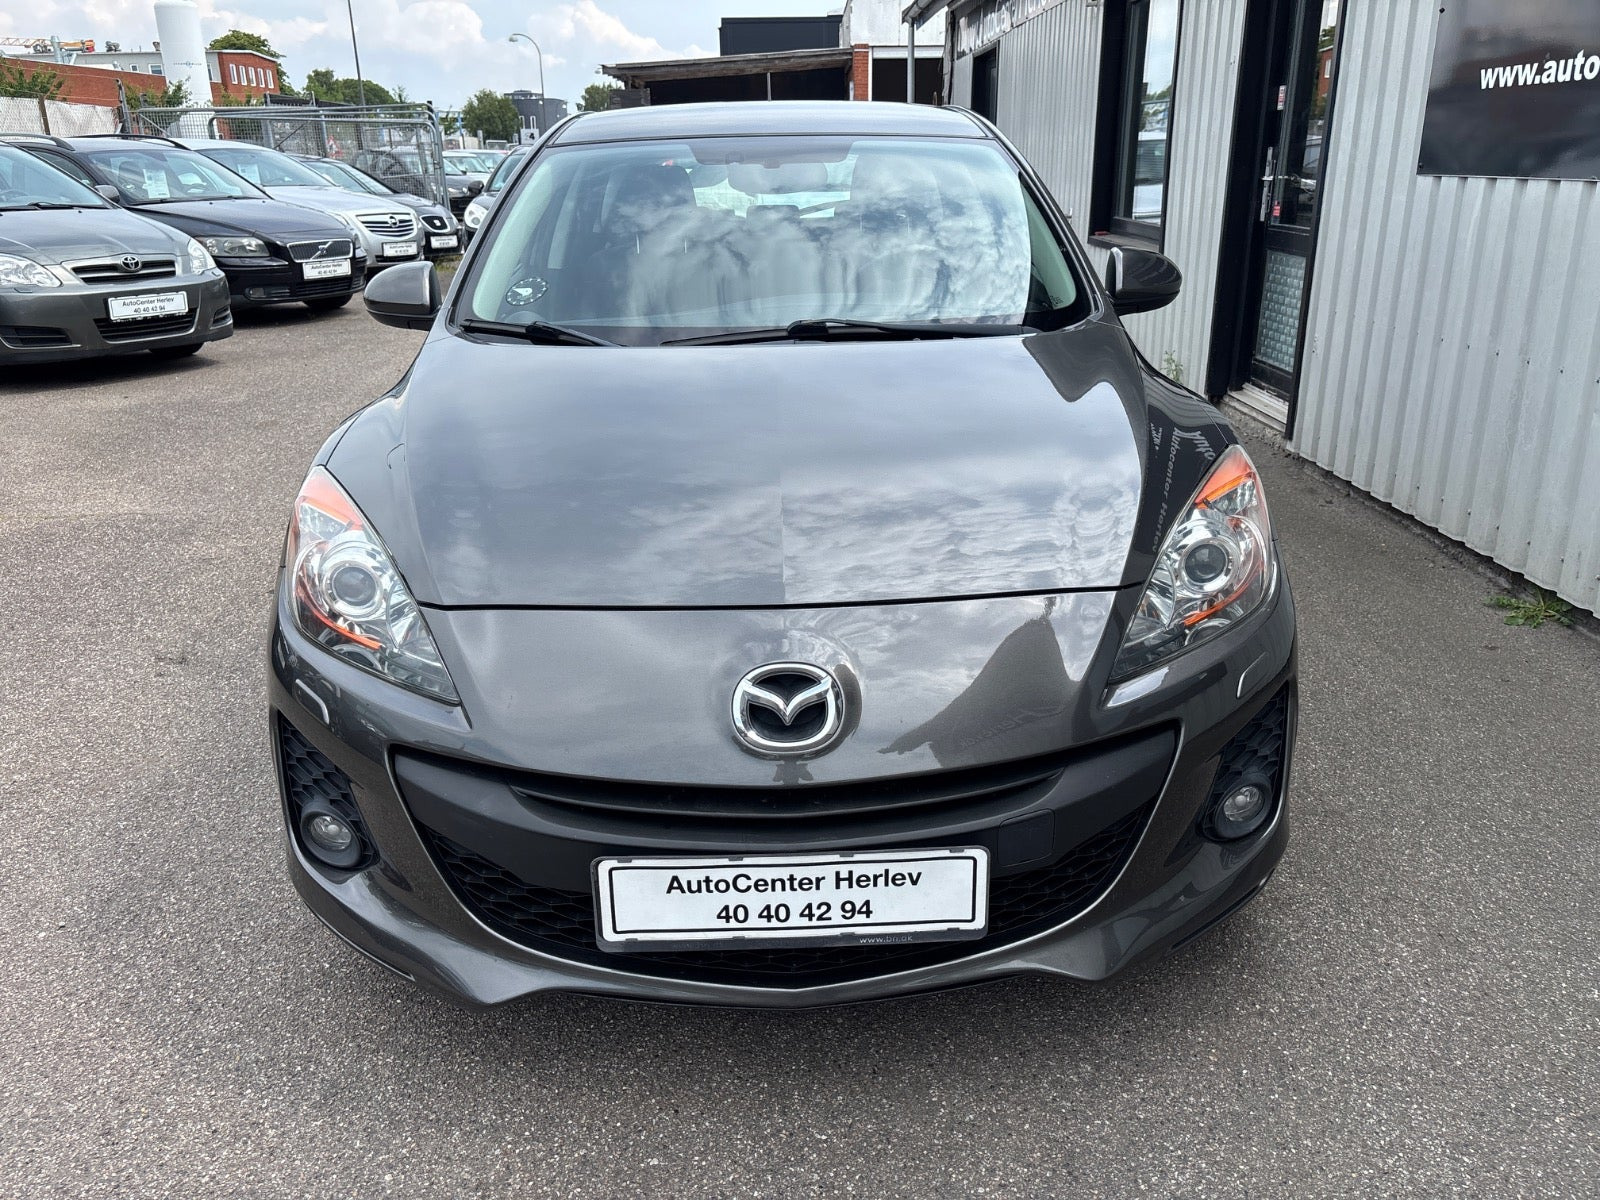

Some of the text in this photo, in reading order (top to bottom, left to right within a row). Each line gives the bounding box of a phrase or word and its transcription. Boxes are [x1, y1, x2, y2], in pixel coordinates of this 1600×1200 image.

[1480, 49, 1600, 90] www.auto
[122, 298, 156, 307] AutoCenter
[666, 868, 923, 895] AutoCenter Herlev
[716, 900, 873, 924] 40 40 42 94
